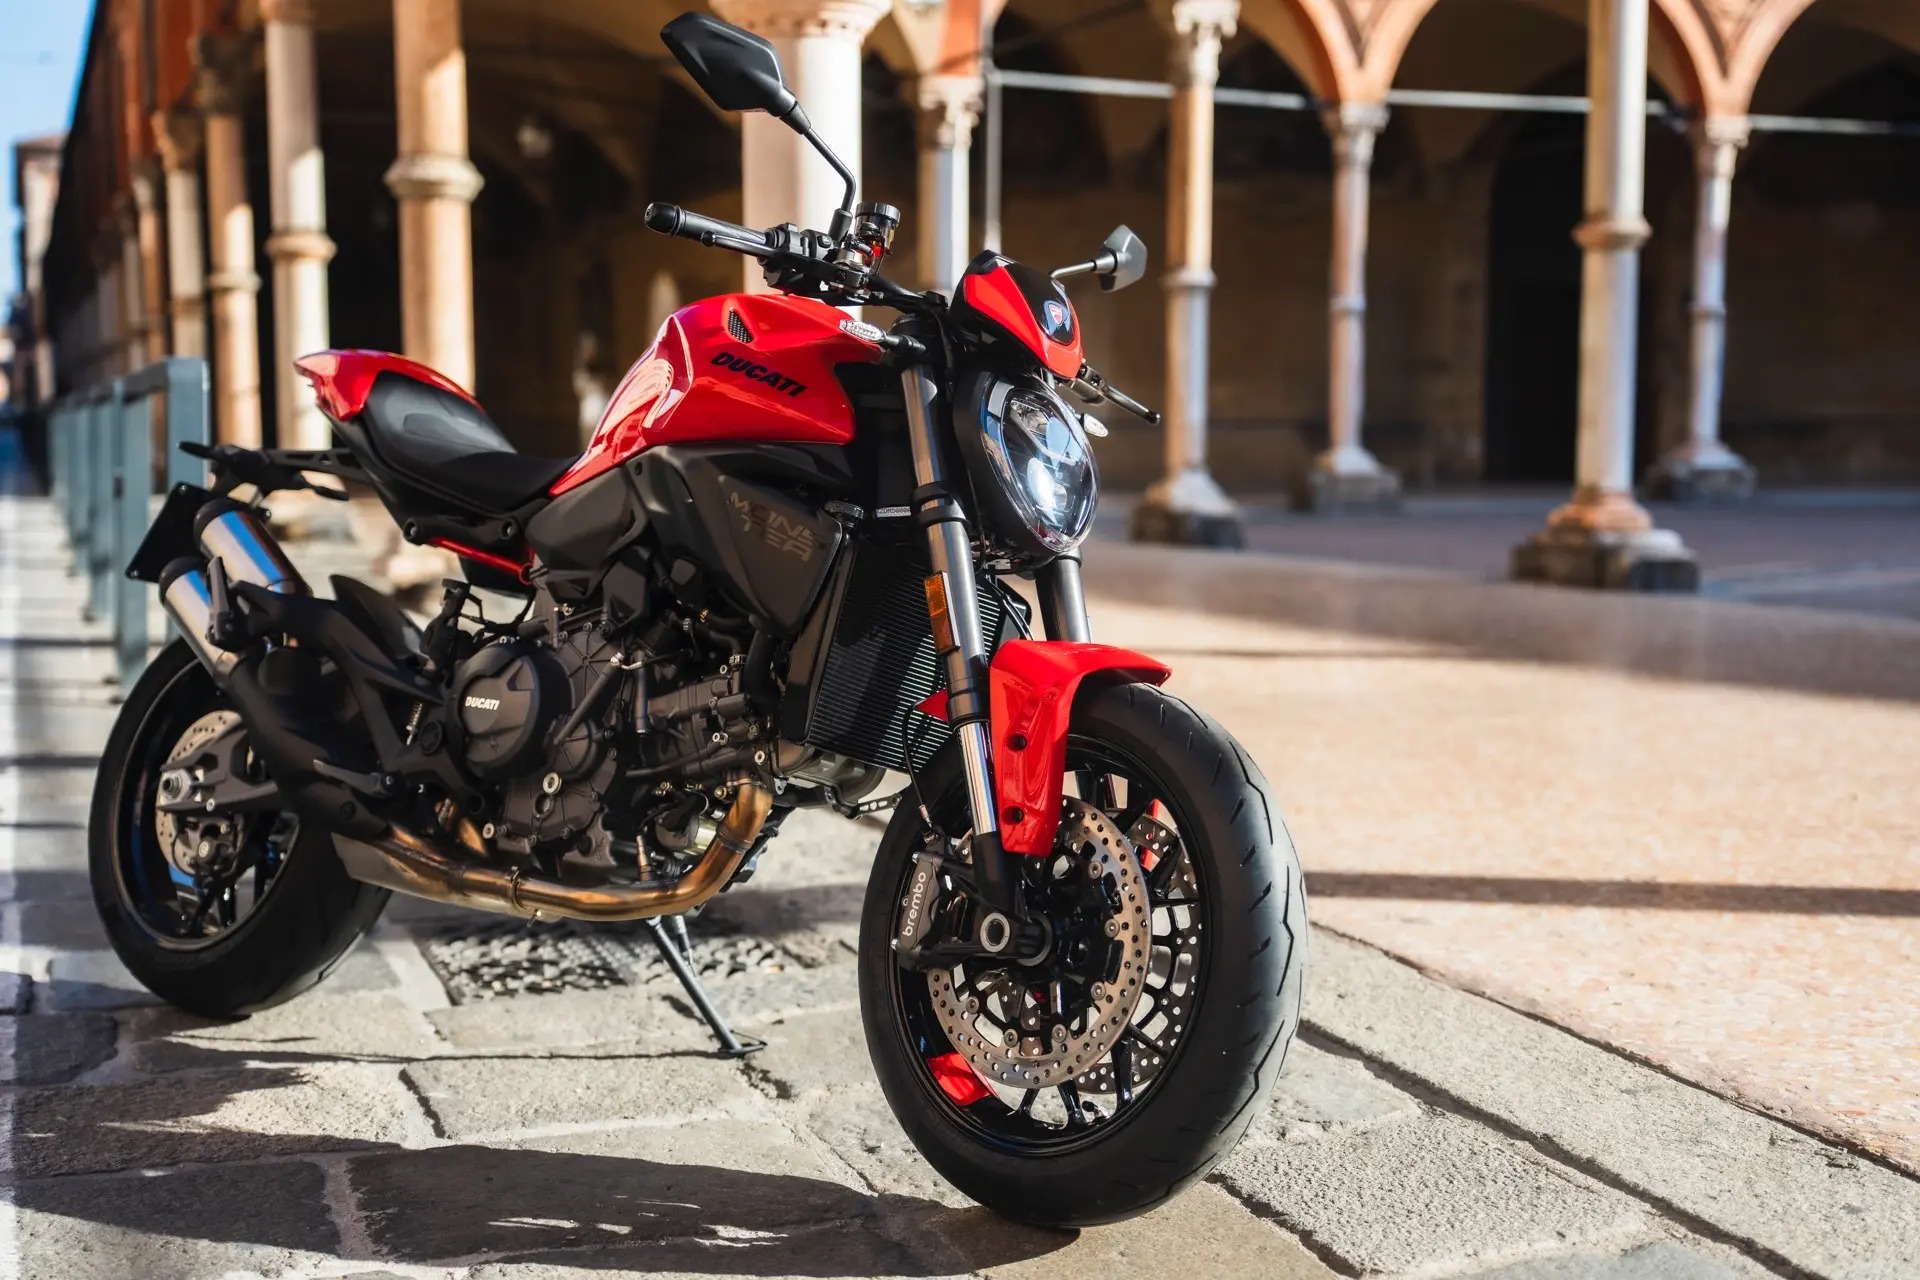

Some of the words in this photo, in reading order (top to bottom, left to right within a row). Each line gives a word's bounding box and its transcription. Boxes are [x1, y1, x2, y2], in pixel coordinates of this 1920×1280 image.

[710, 352, 807, 397] DUCATI
[465, 696, 500, 710] DUCATI
[902, 871, 926, 937] brembo
